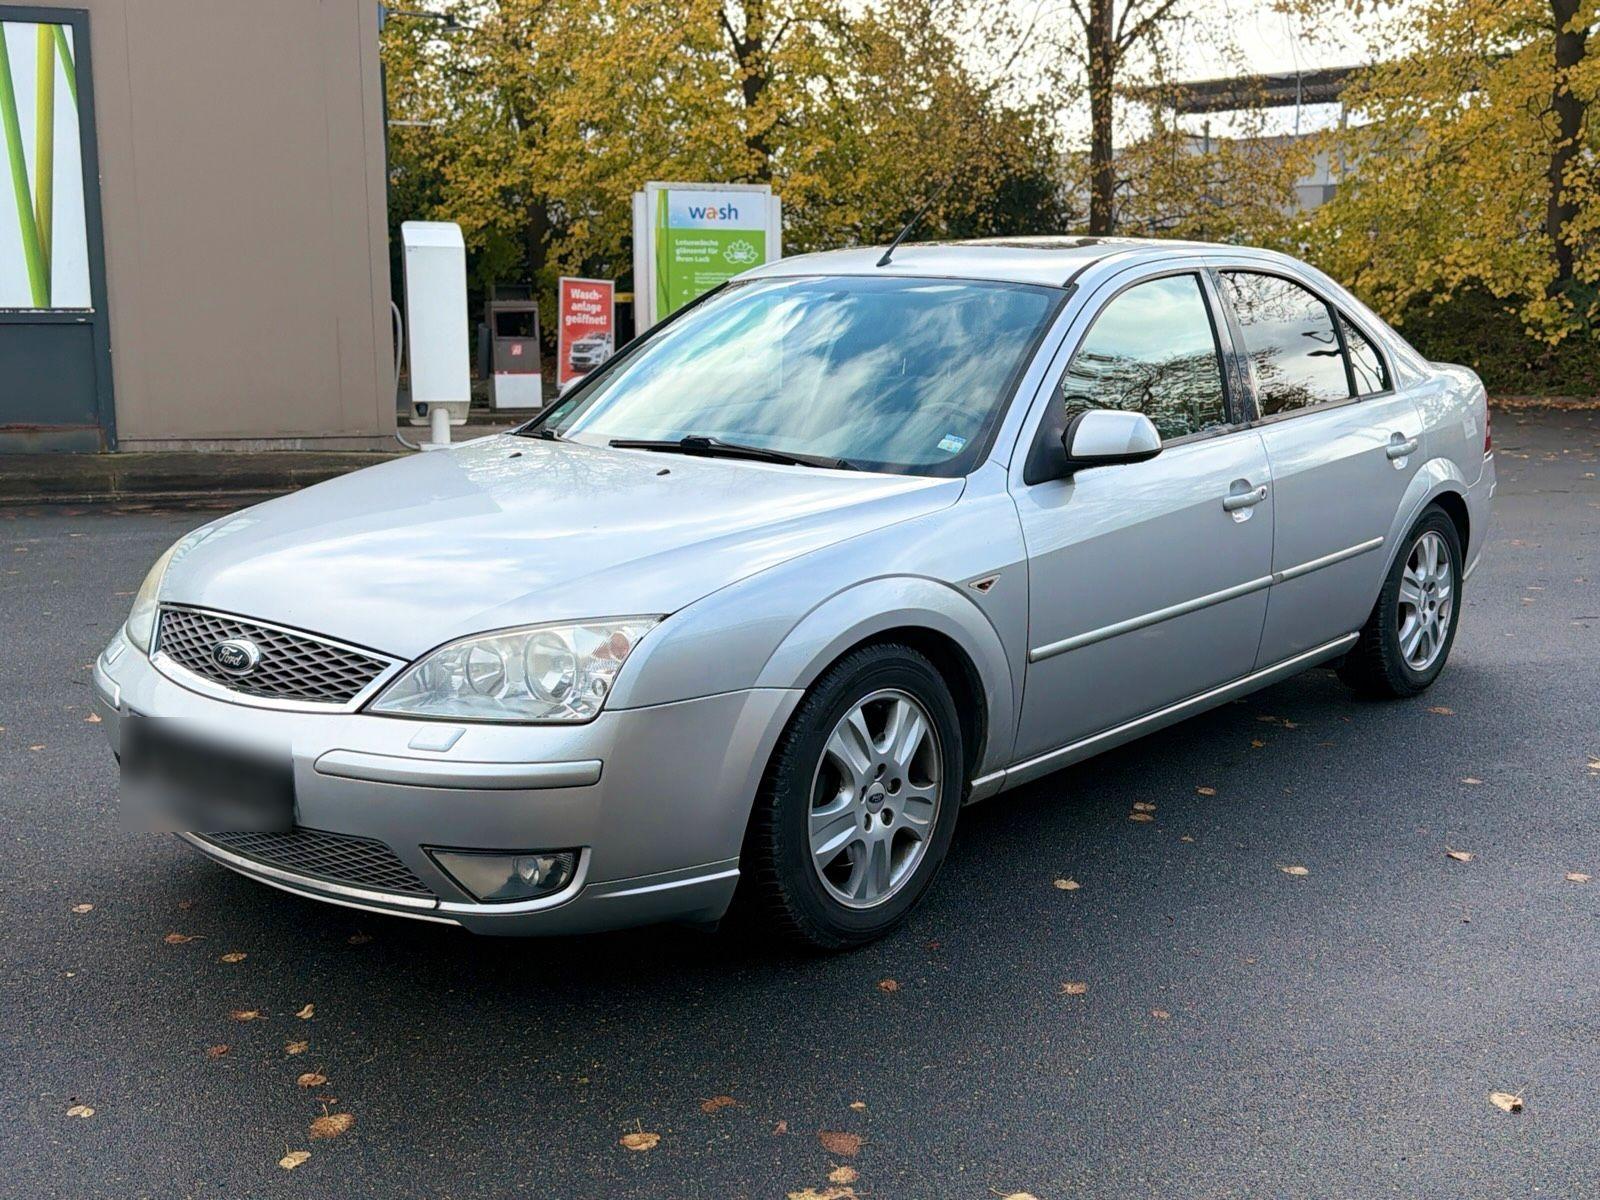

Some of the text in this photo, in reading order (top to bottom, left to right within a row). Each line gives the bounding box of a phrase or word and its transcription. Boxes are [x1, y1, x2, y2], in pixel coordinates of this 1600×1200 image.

[688, 203, 738, 220] wash
[570, 288, 602, 300] Wasch-
[570, 301, 602, 314] anlage
[565, 313, 607, 326] geöffnet!
[217, 646, 243, 666] Ford
